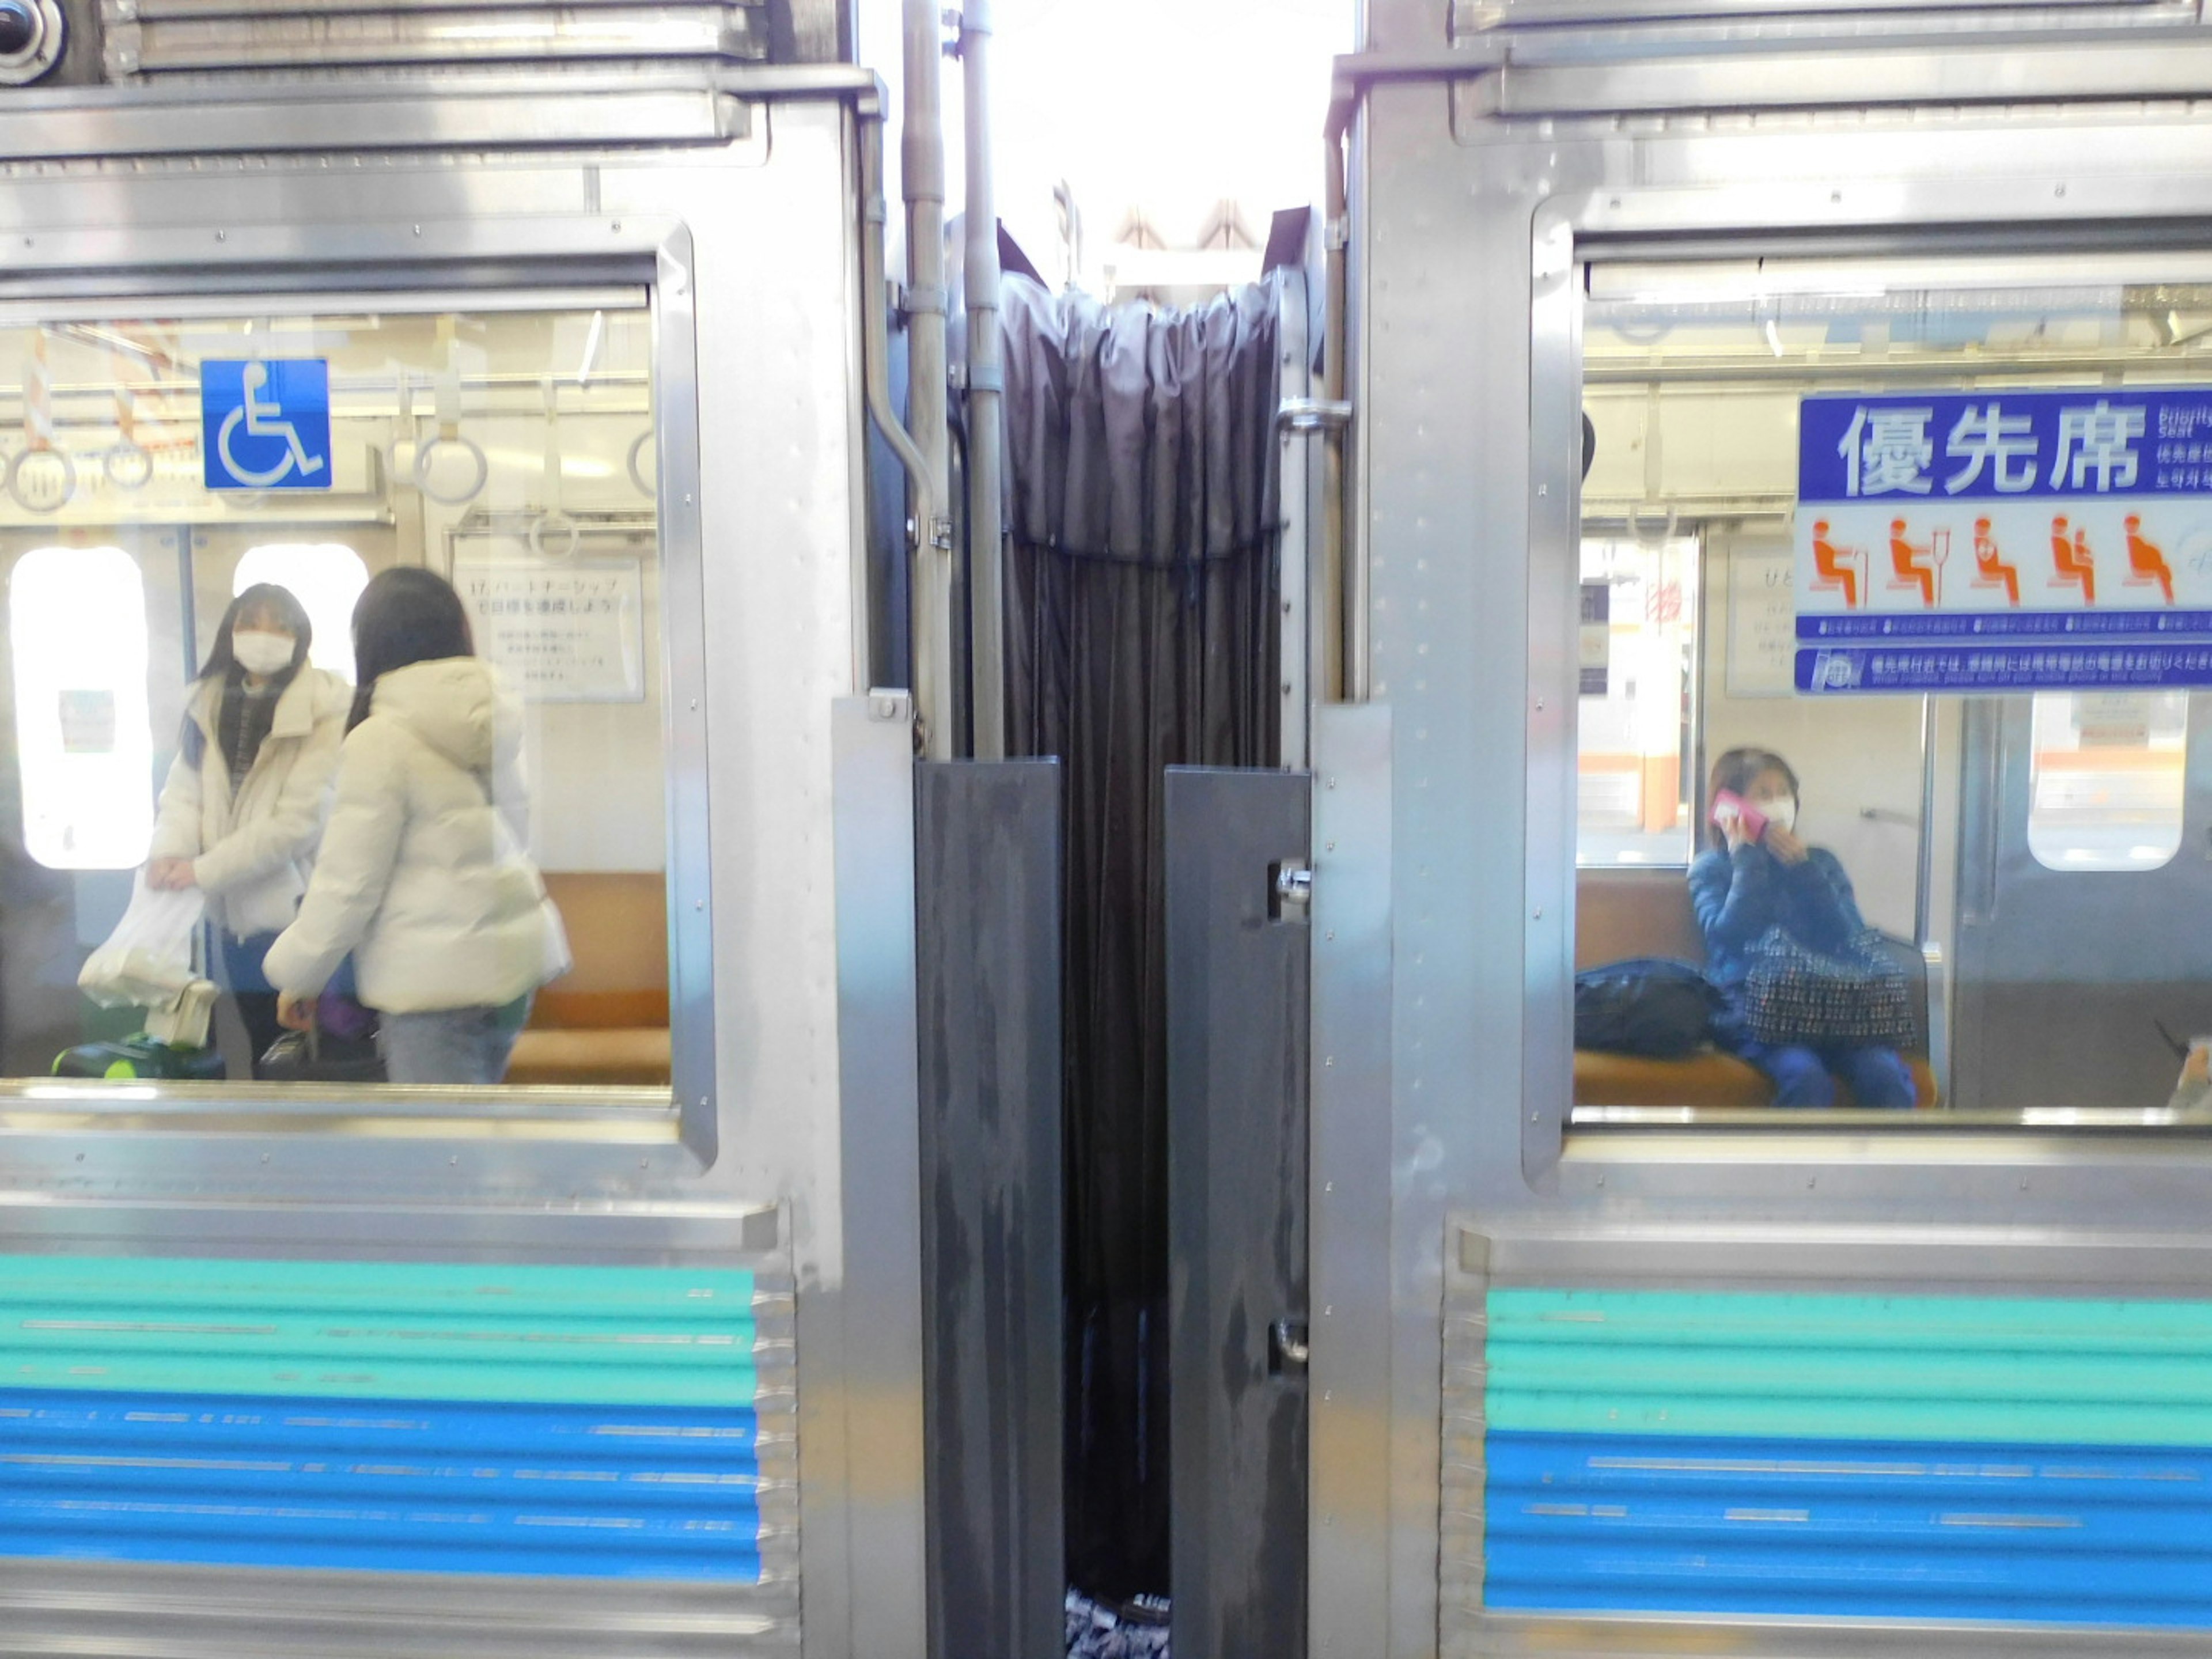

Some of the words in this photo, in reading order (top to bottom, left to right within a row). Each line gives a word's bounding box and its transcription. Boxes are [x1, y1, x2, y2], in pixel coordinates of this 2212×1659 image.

[1838, 399, 2147, 497] 優先席
[2158, 425, 2193, 438] Seat
